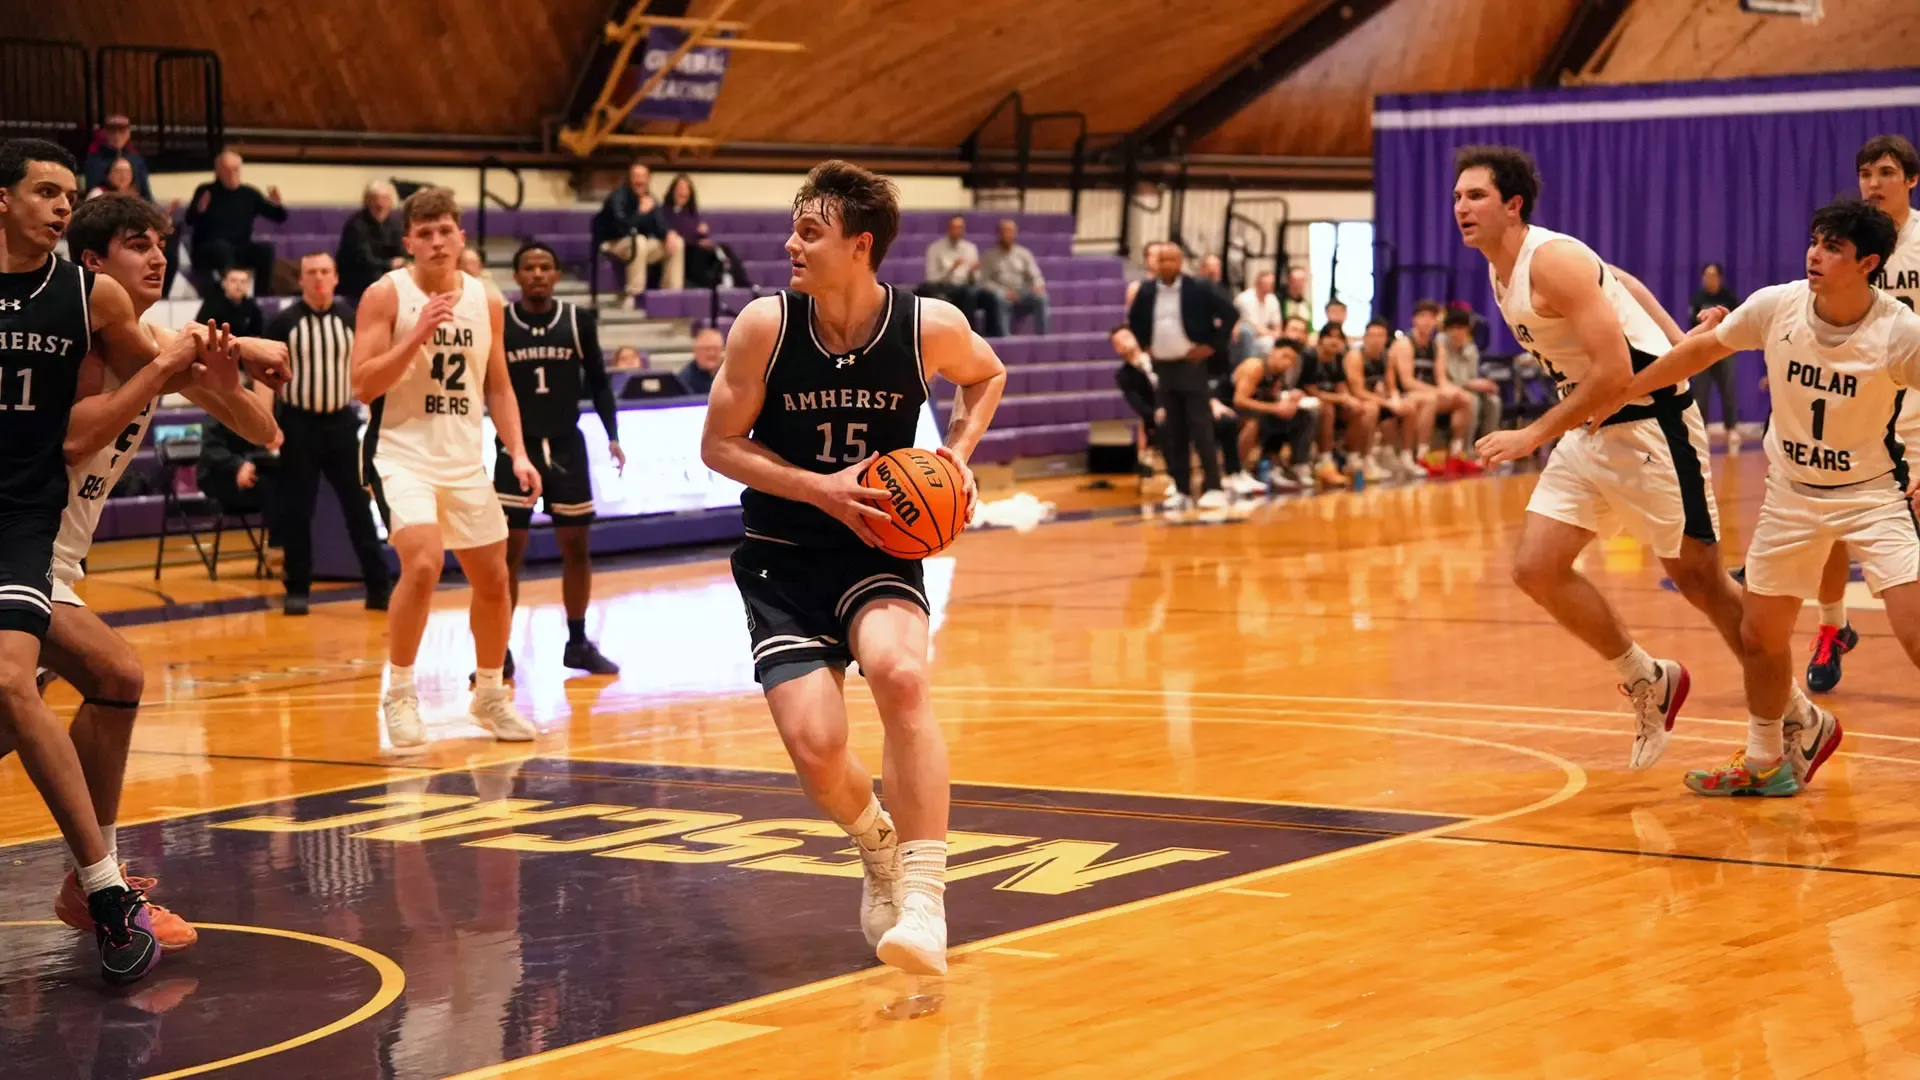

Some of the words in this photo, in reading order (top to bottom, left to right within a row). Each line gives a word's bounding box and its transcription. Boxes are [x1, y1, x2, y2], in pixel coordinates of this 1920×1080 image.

[423, 328, 473, 347] OLAR
[507, 346, 573, 364] AMHERST
[431, 352, 466, 391] 42
[534, 365, 549, 394] 1
[1787, 360, 1858, 398] POLAR
[783, 388, 904, 411] AMHERST
[1810, 398, 1826, 441] 1
[816, 422, 868, 463] 15
[876, 461, 921, 527] Wilson
[206, 793, 1230, 894] NESCAC
